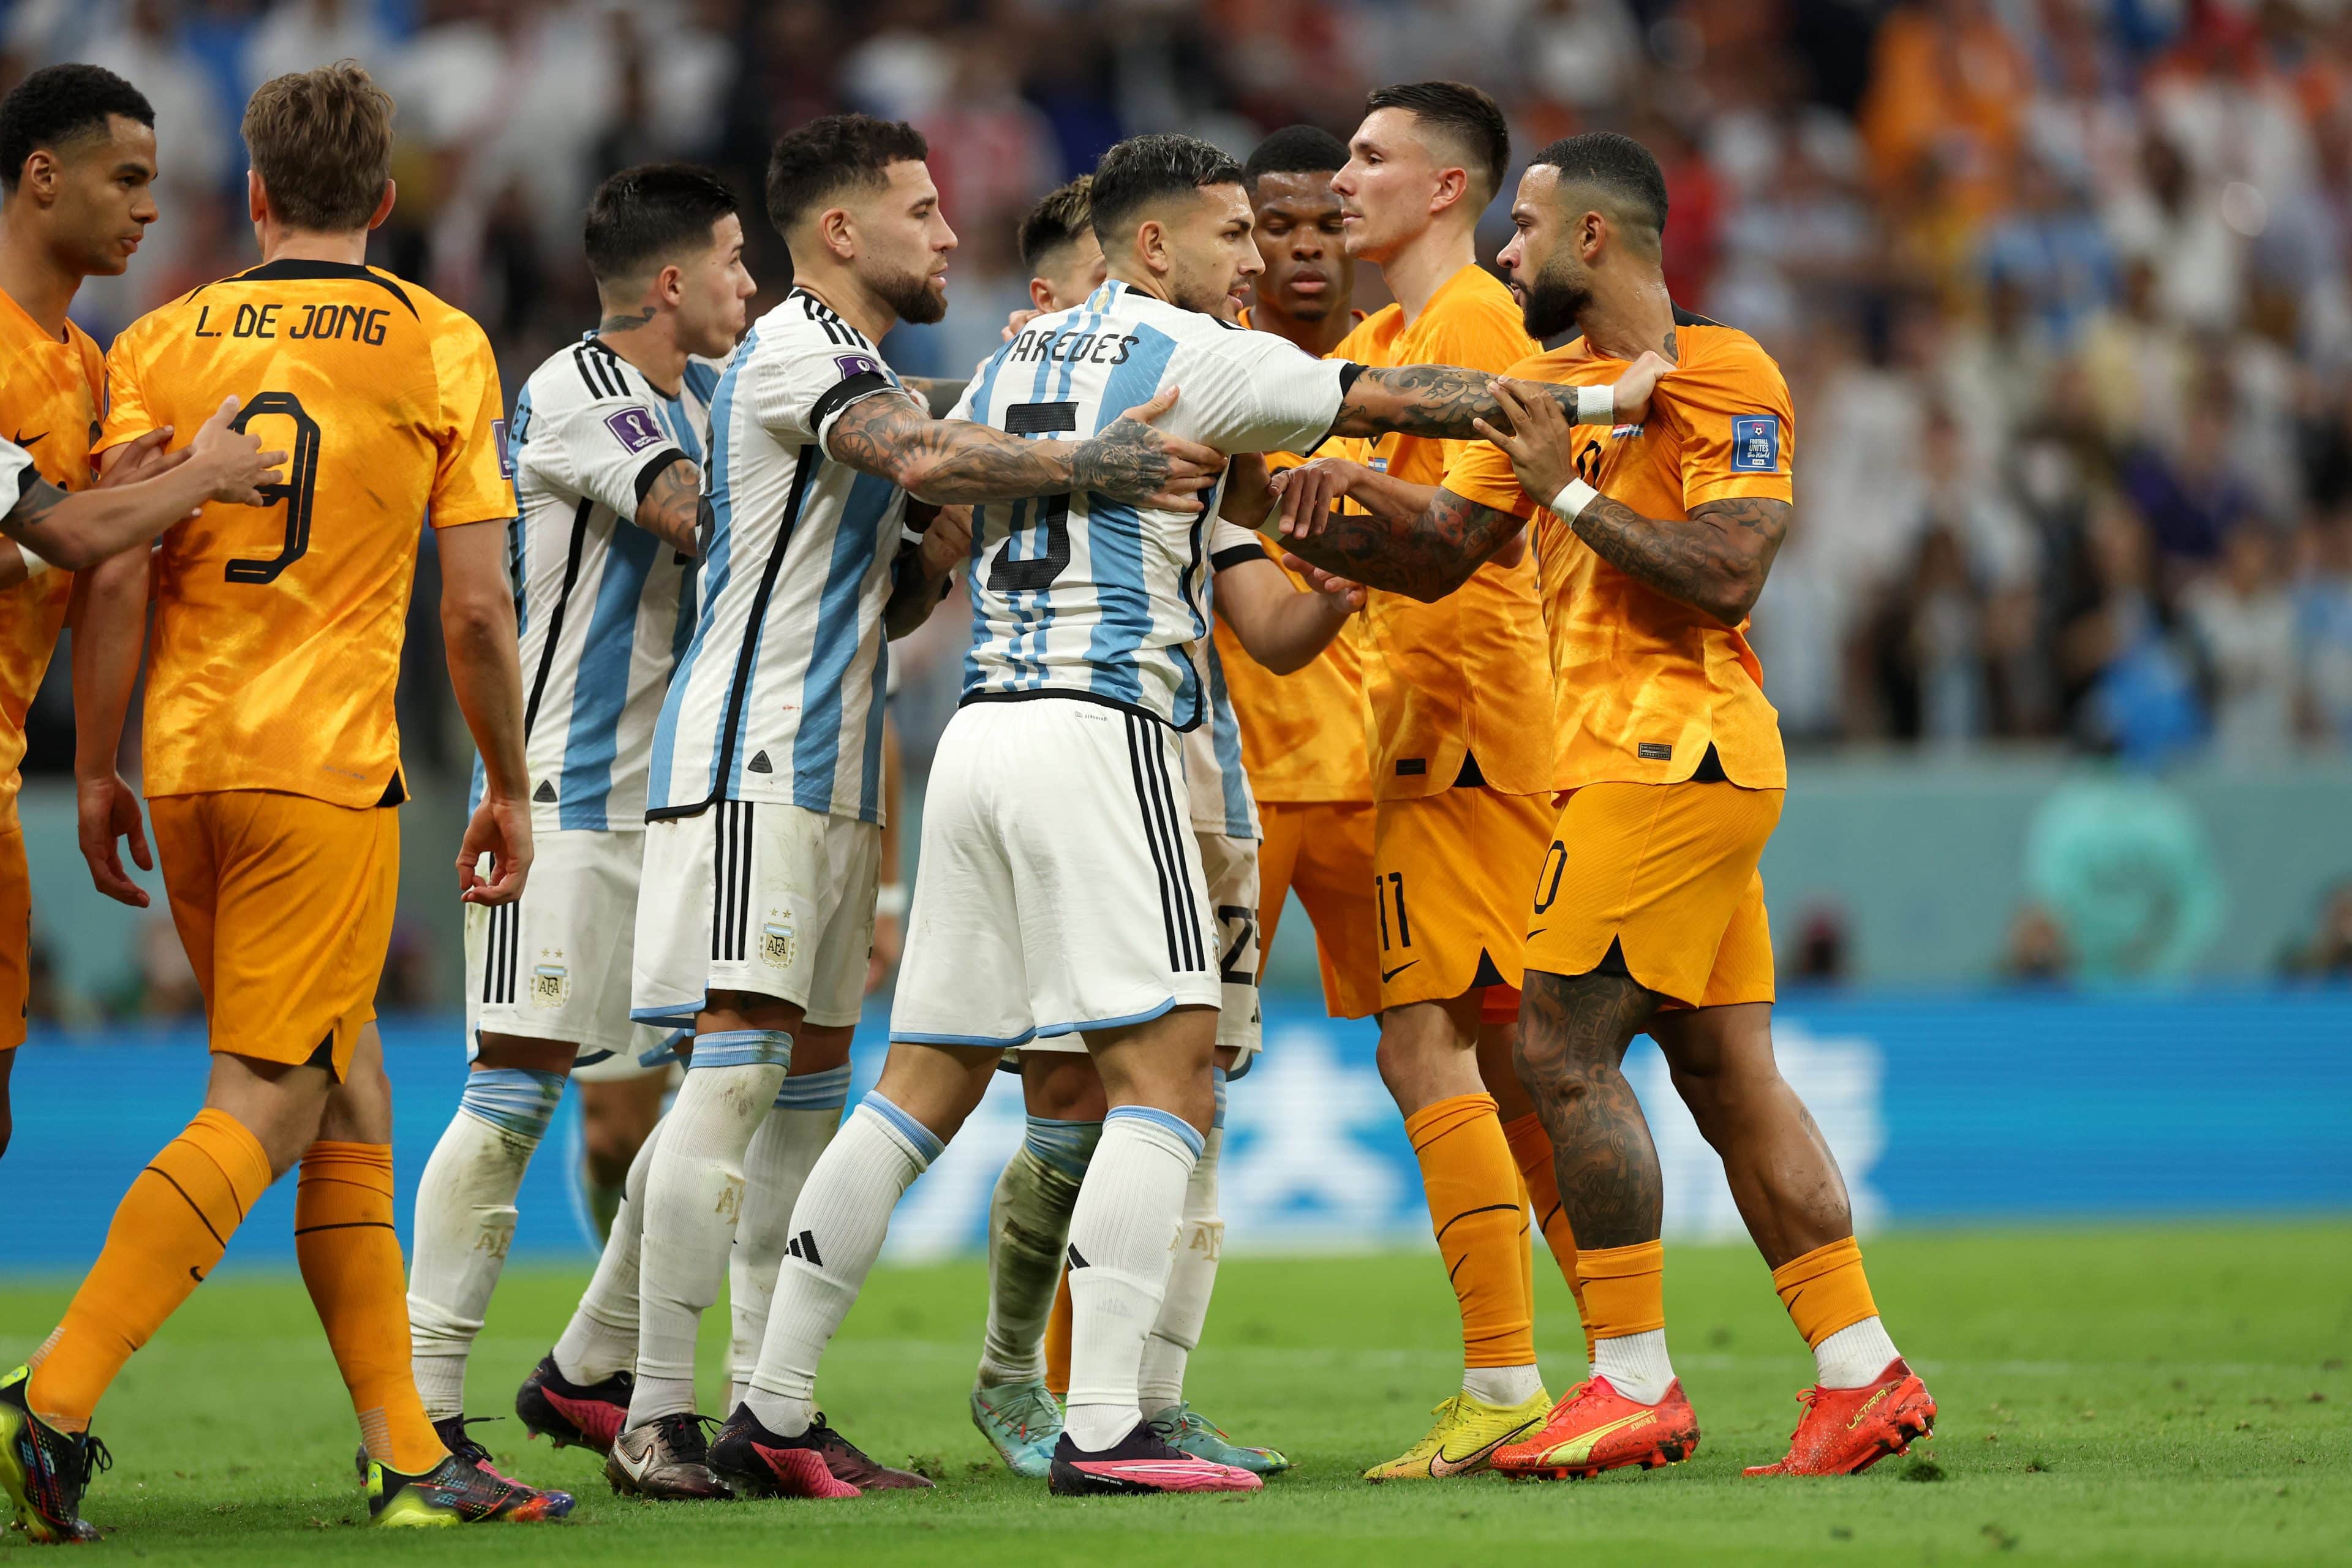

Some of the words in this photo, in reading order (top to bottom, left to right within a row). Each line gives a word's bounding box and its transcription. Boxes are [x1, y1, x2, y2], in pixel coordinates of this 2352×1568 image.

[195, 306, 222, 337] L.
[233, 304, 283, 338] DE
[290, 304, 391, 346] JONG
[225, 391, 321, 584] 9
[987, 401, 1079, 591] 5
[1376, 872, 1412, 951] 11
[766, 934, 786, 957] AFA
[538, 975, 560, 997] AFA
[1846, 1387, 1888, 1431] ULTRA
